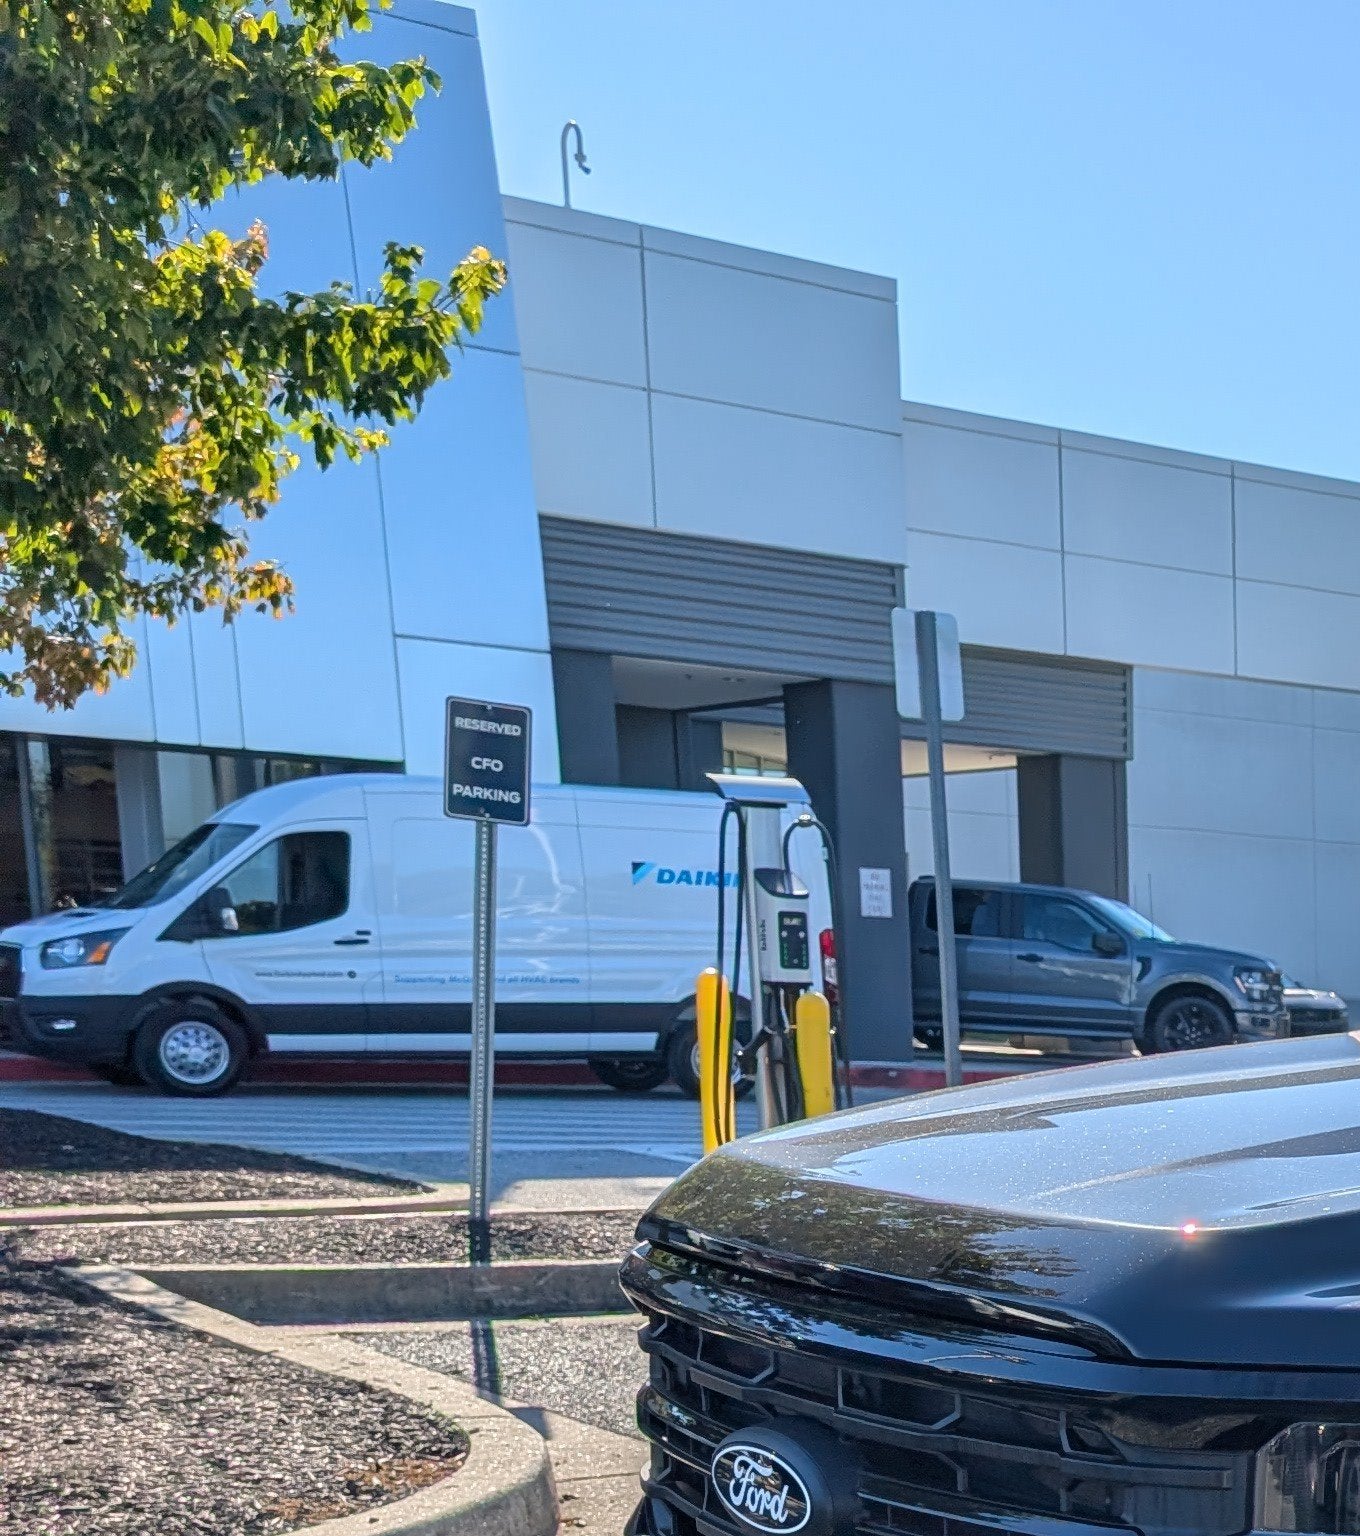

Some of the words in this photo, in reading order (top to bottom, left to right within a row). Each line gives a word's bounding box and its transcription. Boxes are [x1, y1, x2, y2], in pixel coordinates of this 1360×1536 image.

[455, 717, 521, 736] RESERVED
[471, 757, 504, 772] CFO
[453, 783, 521, 804] PARKING
[657, 868, 739, 888] DAIKI
[729, 1455, 790, 1523] Ford
